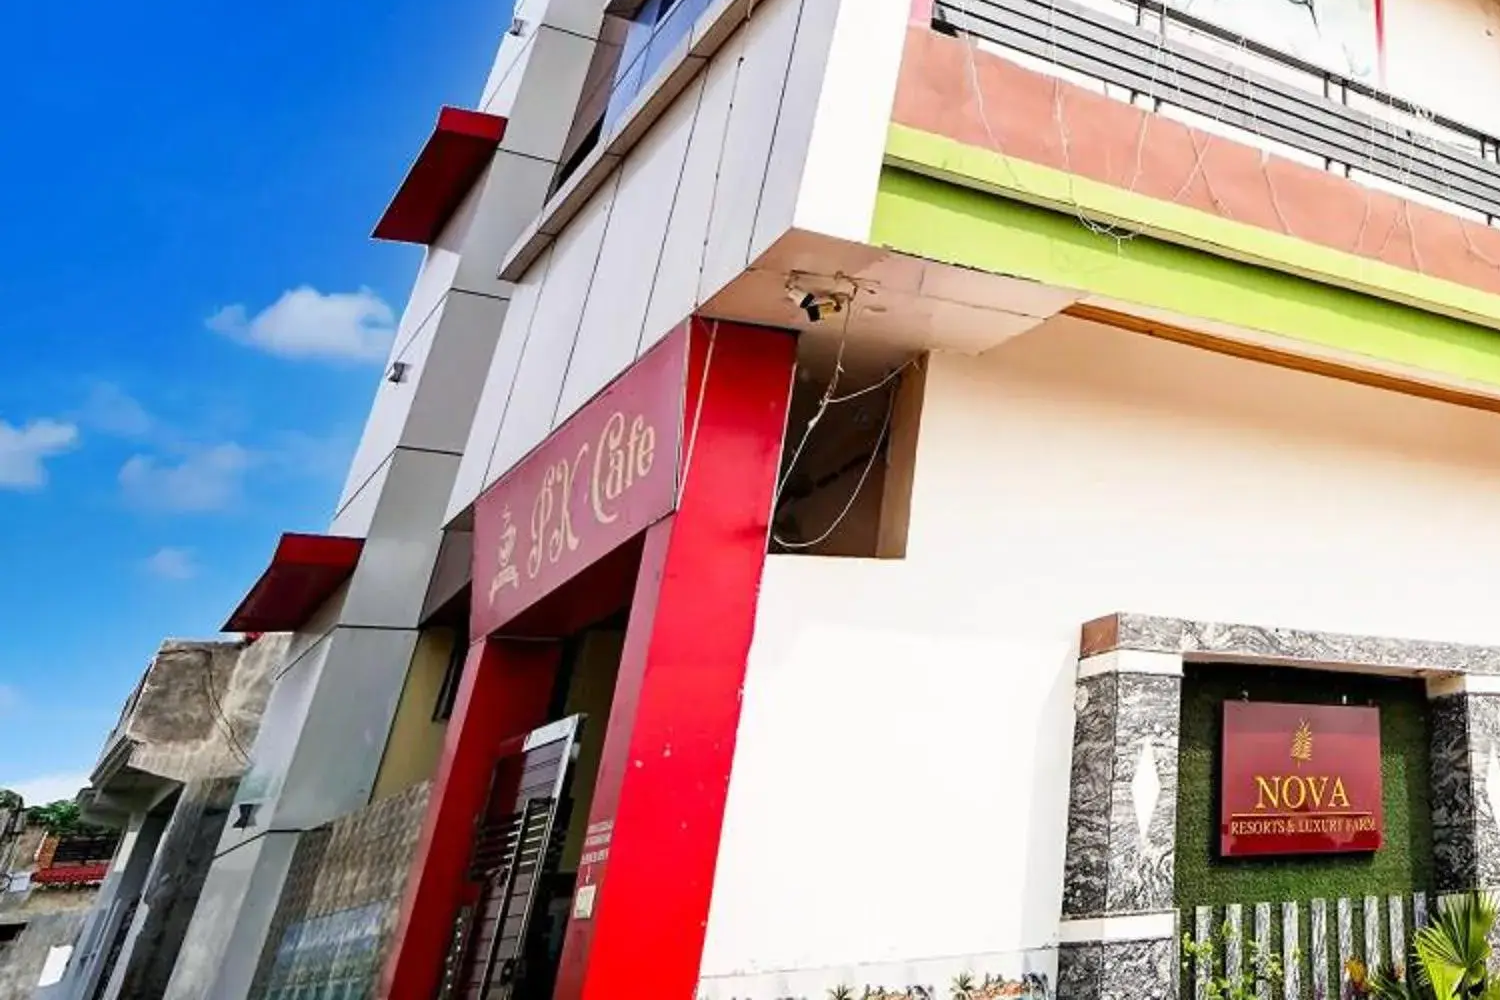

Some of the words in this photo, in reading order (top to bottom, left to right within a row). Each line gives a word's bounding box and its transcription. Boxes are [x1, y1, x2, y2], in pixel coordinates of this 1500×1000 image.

[592, 411, 656, 524] Cafe
[1254, 775, 1351, 809] NOVA
[1231, 818, 1285, 835] RESORTS
[1286, 819, 1295, 833] &
[1297, 818, 1343, 833] LUXURY
